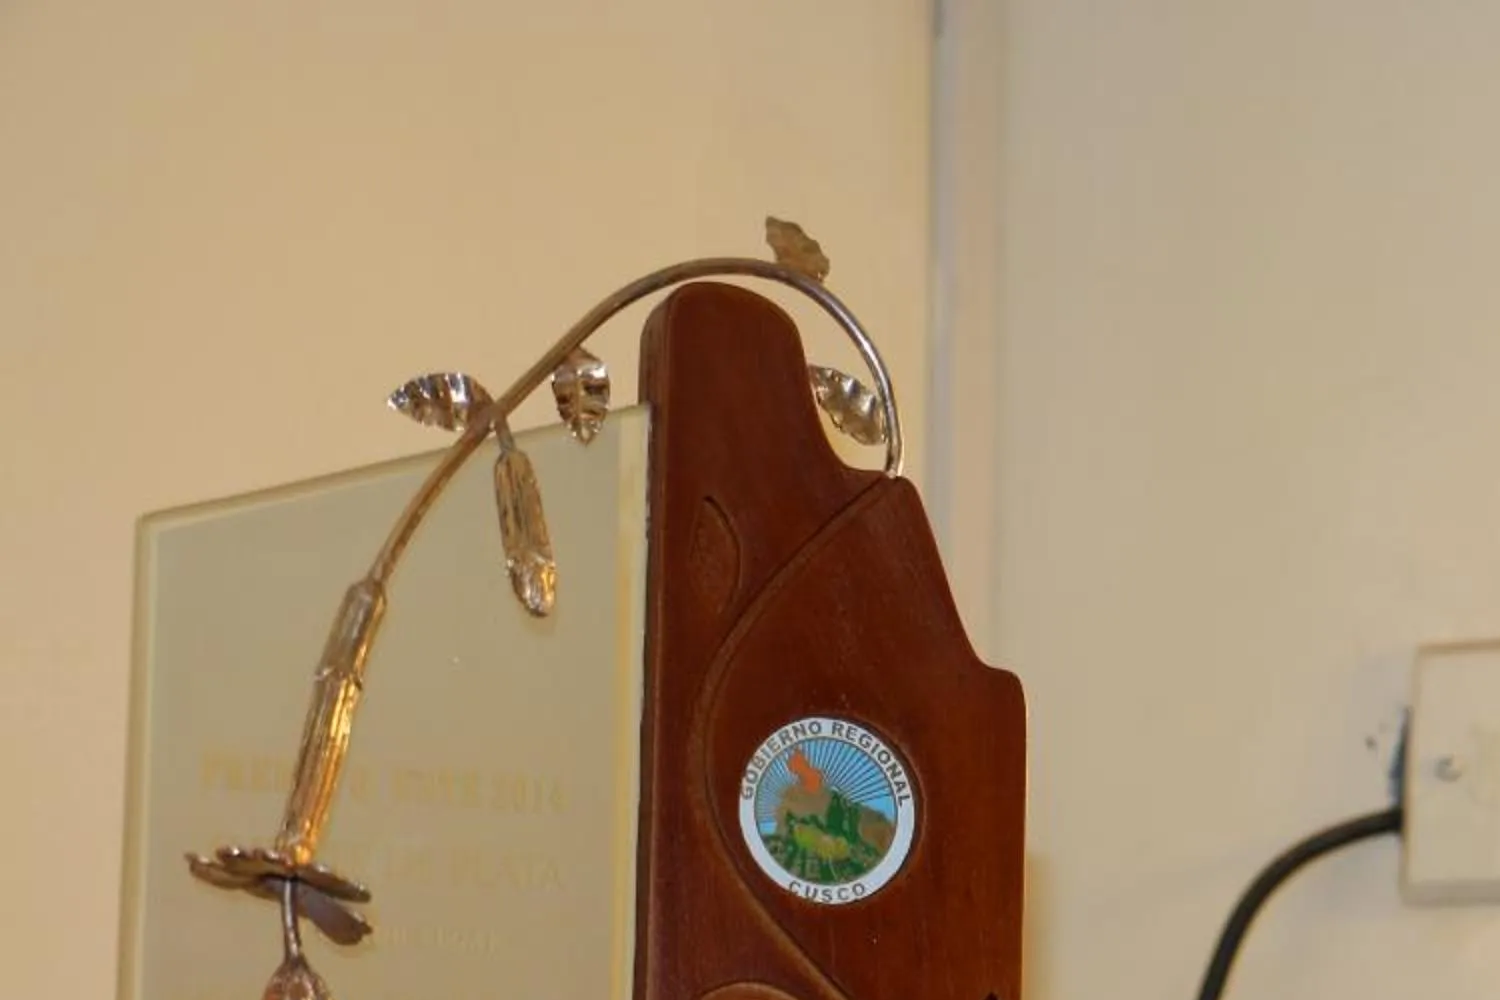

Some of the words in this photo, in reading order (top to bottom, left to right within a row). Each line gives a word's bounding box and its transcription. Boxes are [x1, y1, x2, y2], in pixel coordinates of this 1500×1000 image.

[741, 720, 822, 800] GOBIERNO
[831, 721, 911, 808] REGIONAL
[788, 880, 866, 903] CUSCO
